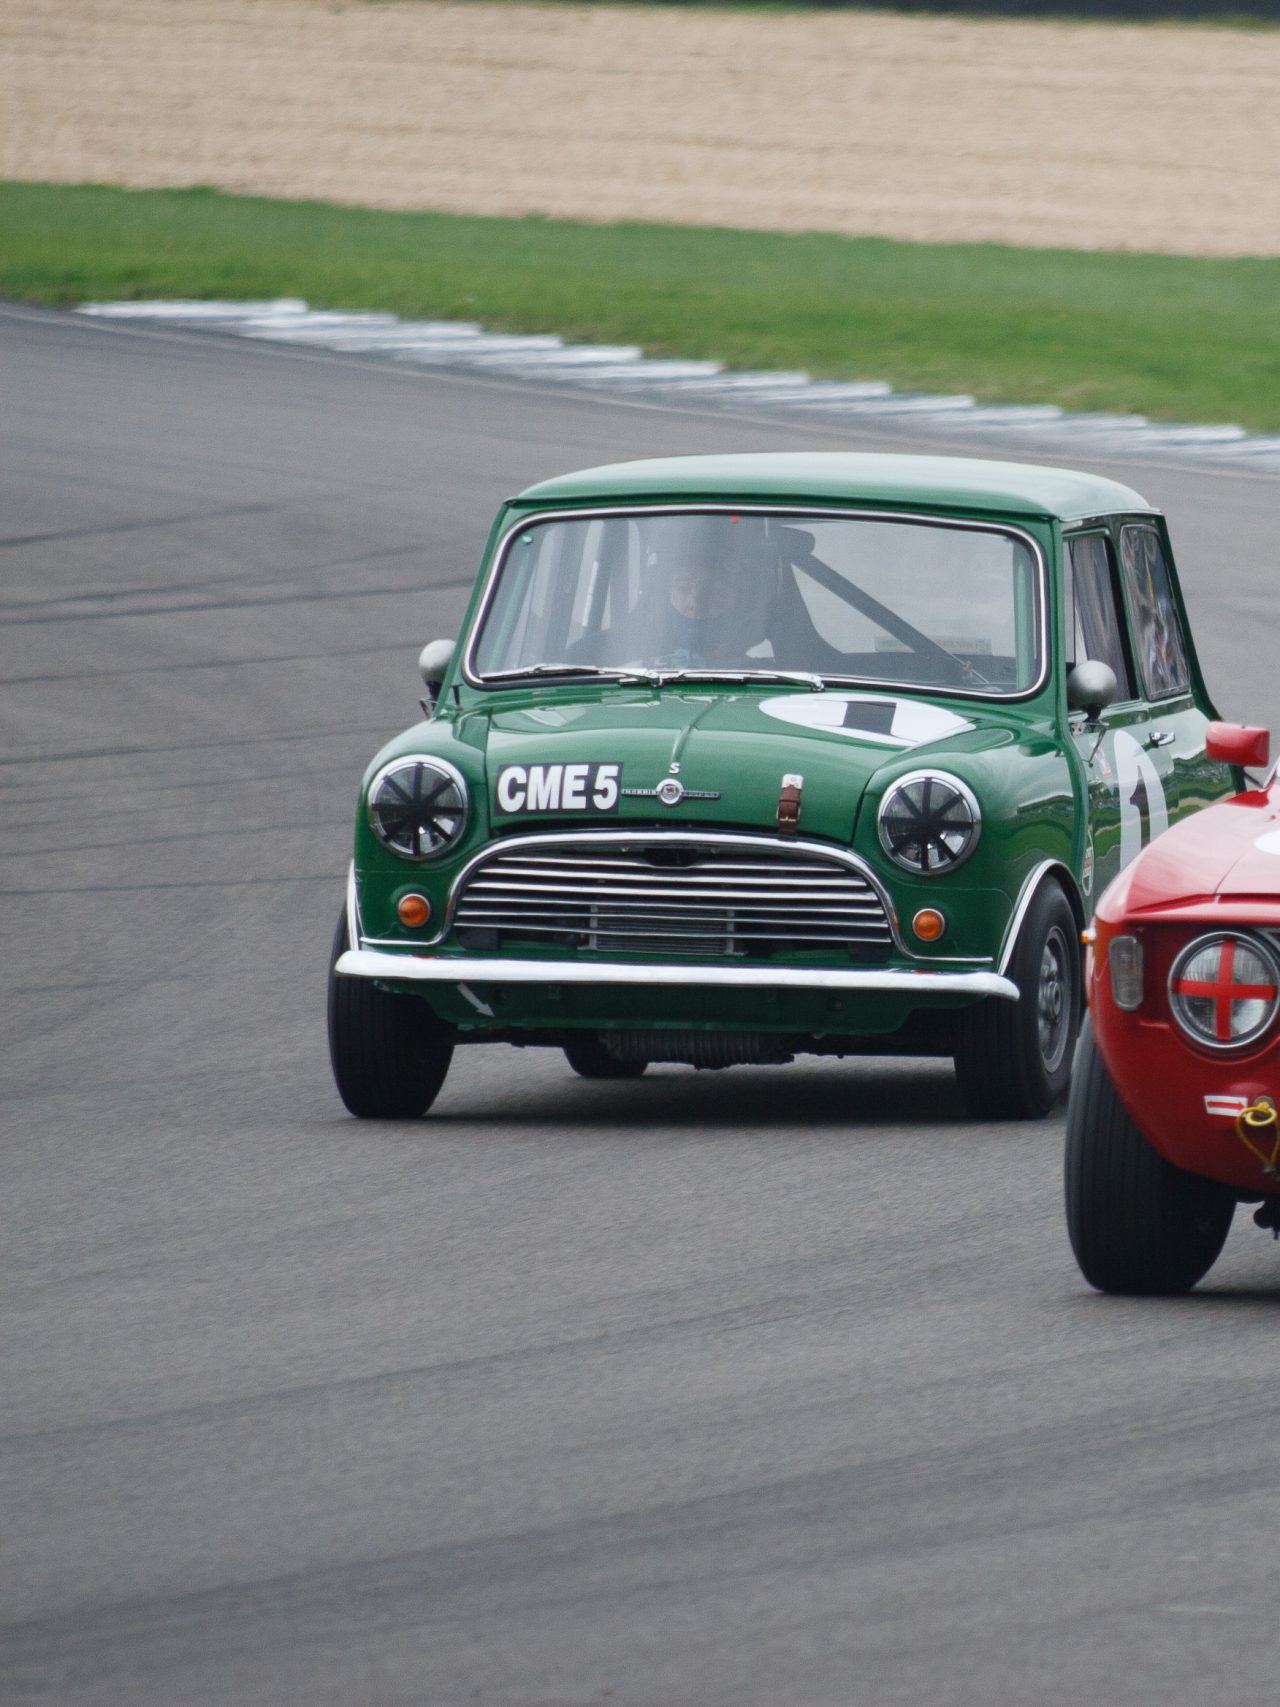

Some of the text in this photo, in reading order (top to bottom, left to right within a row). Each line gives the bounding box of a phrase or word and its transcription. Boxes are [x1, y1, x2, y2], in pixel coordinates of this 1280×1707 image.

[498, 764, 619, 812] CME 5
[668, 762, 681, 774] S
[1129, 765, 1151, 851] 1
